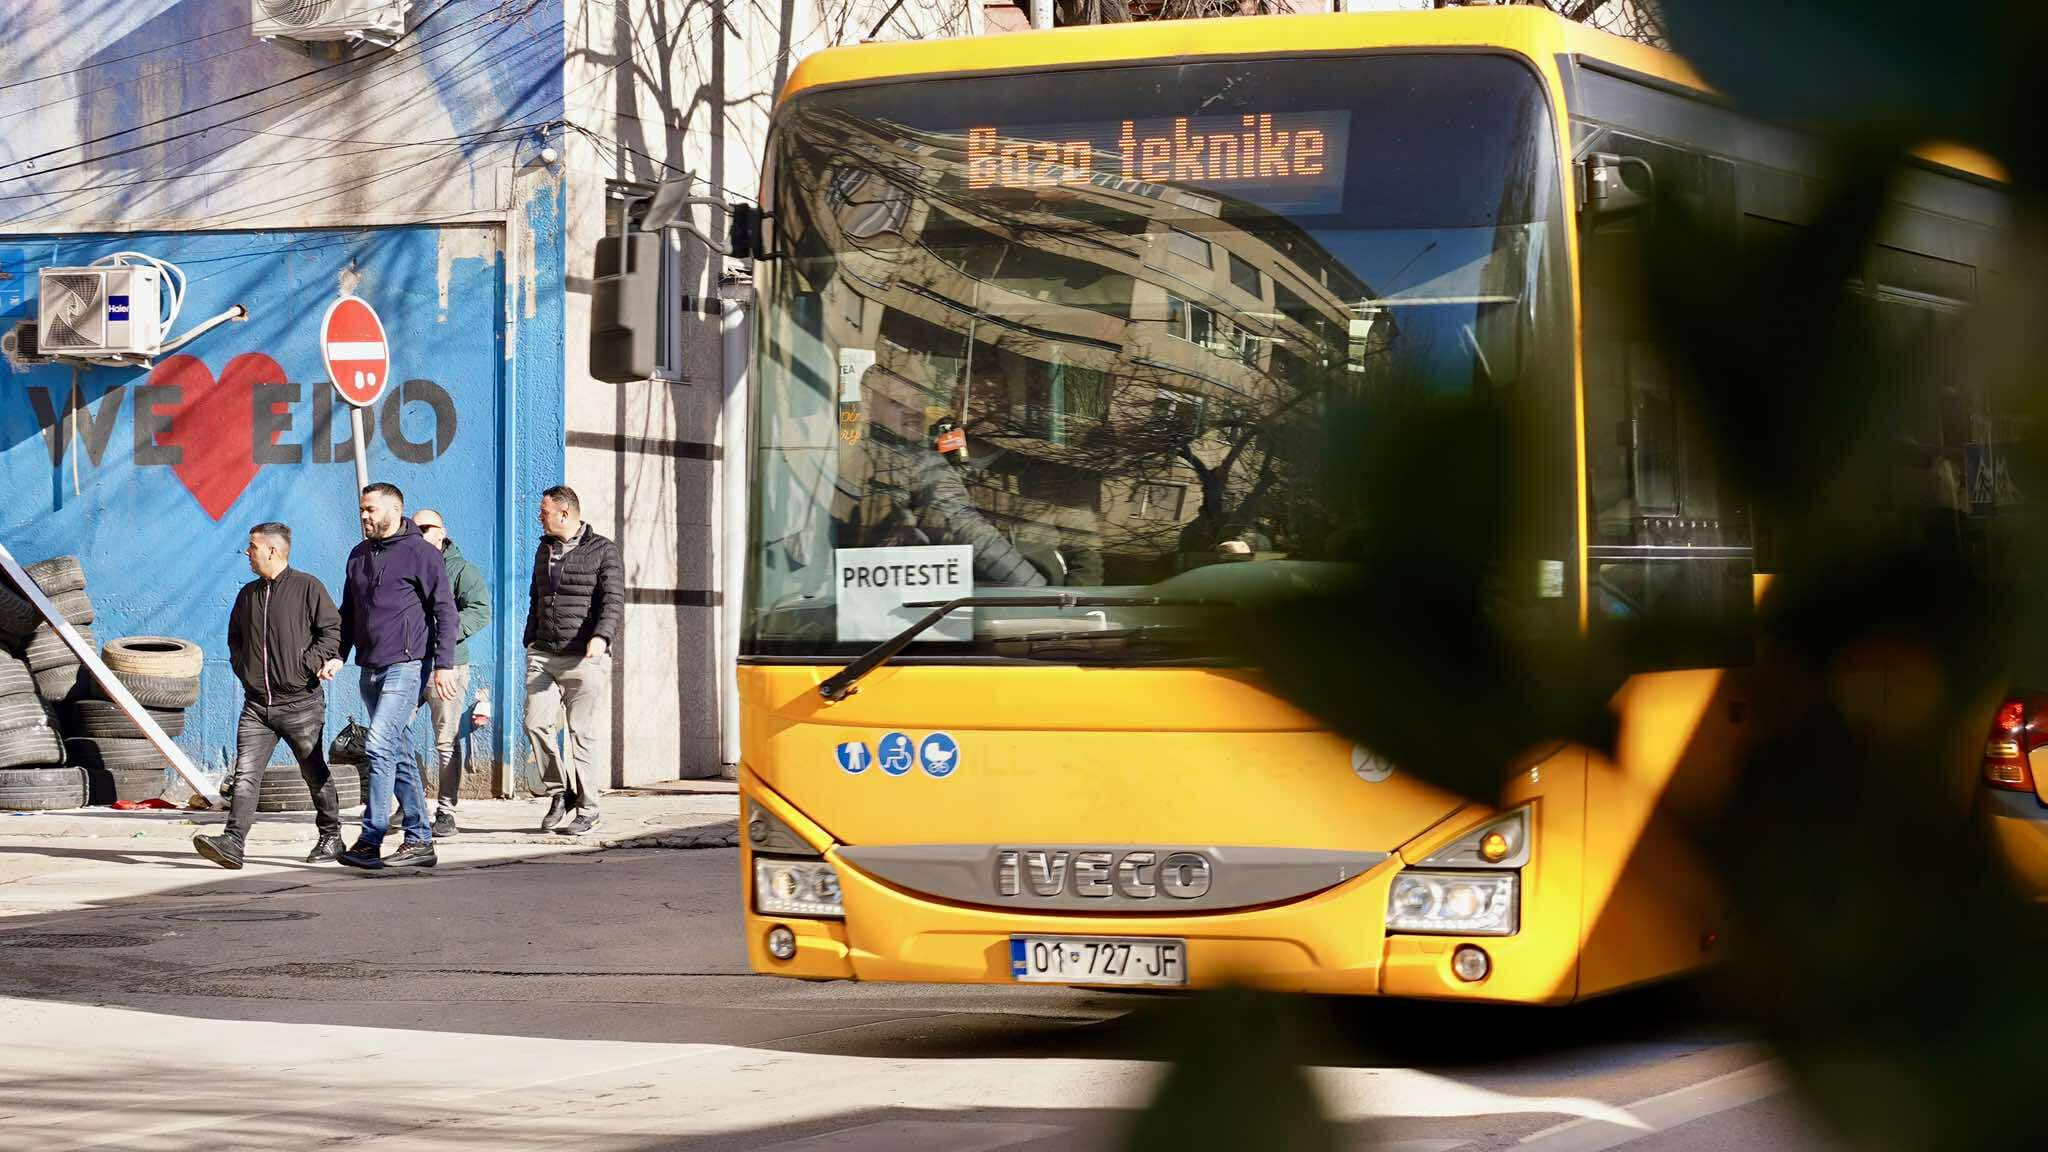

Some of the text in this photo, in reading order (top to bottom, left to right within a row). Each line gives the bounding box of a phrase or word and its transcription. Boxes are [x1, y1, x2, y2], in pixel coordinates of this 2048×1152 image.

[1119, 114, 1324, 182] teknike
[108, 304, 130, 313] Haier
[27, 379, 458, 466] WE EDO
[843, 558, 960, 588] PROTESTË
[998, 850, 1213, 899] IVECO
